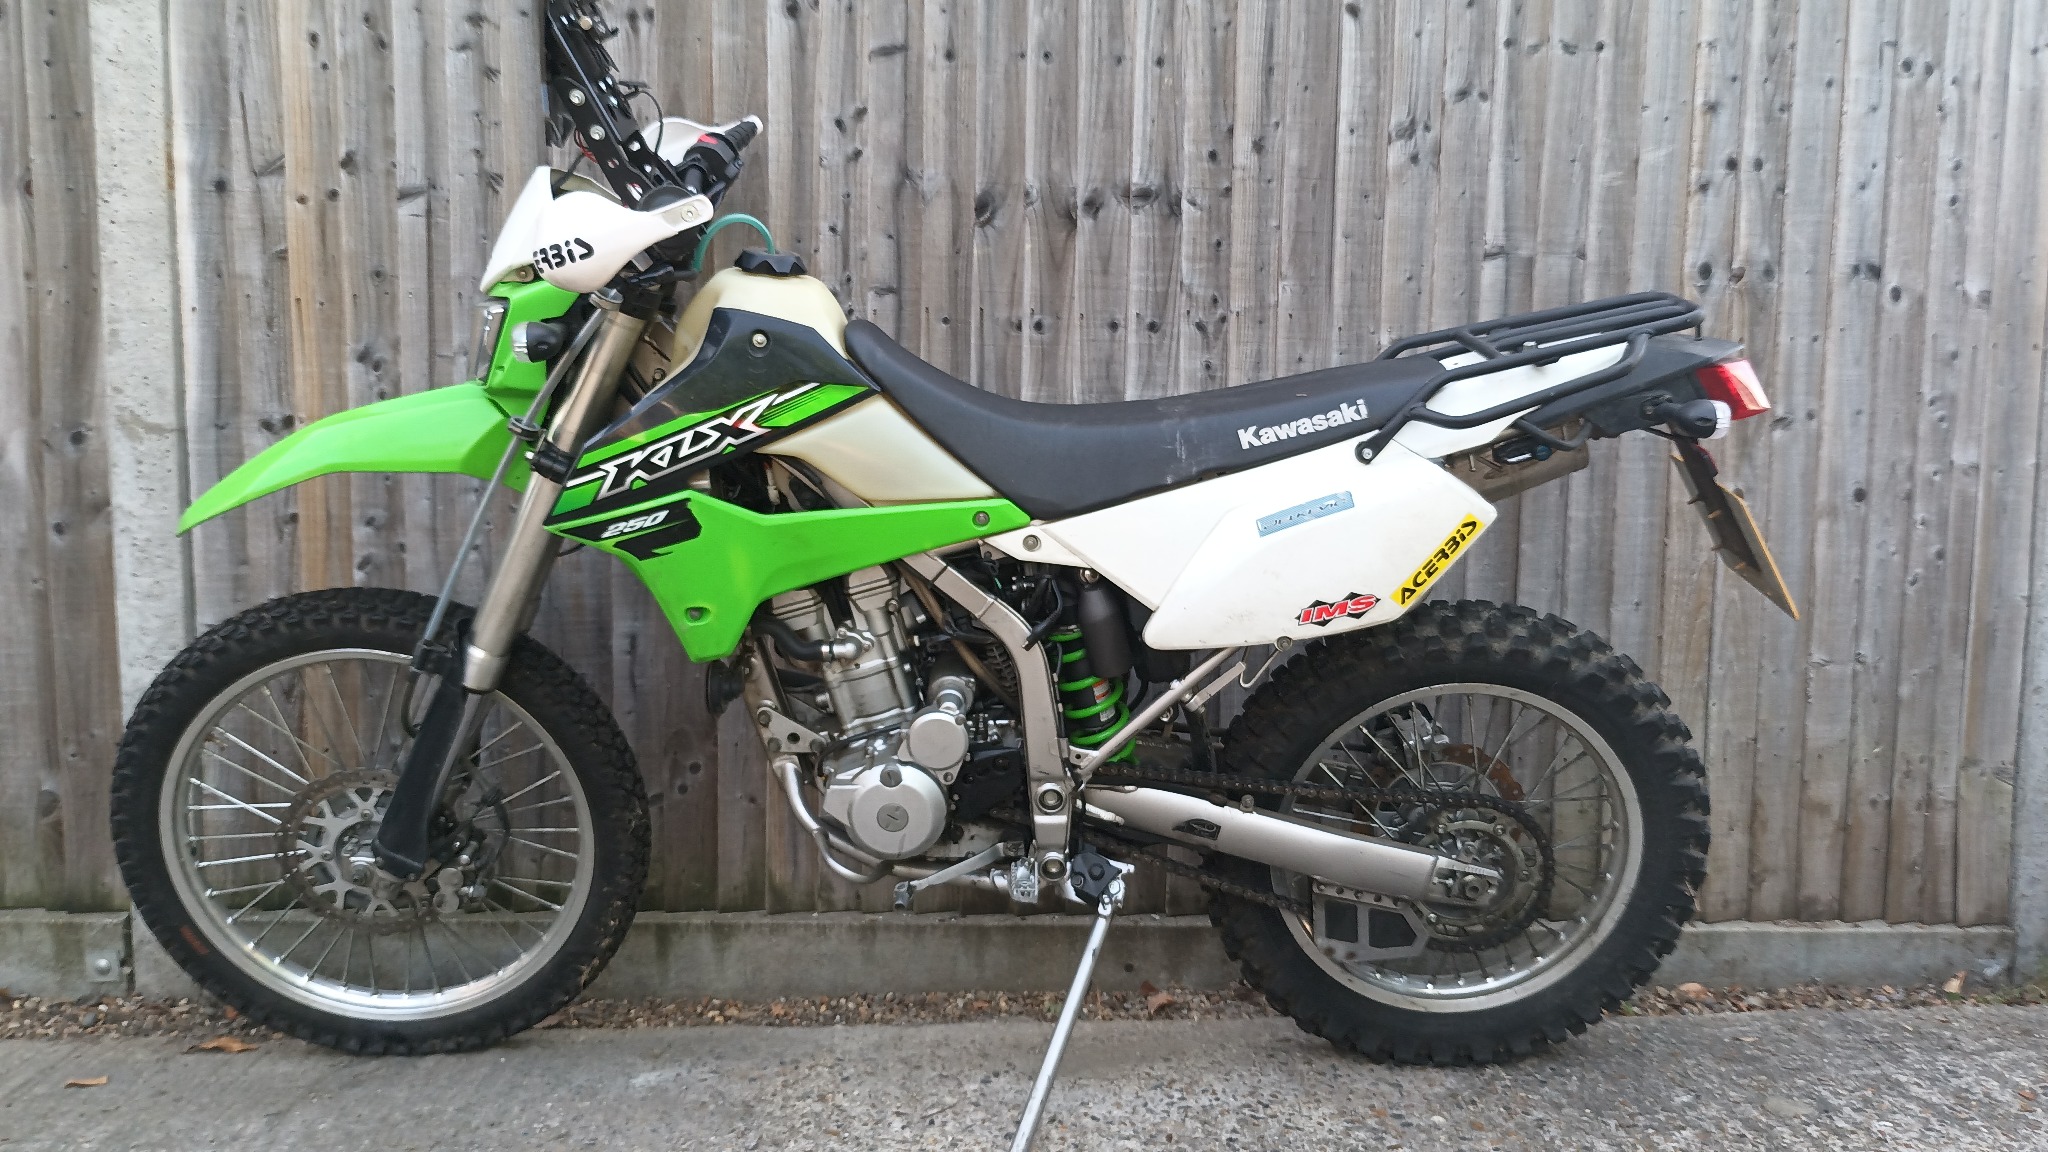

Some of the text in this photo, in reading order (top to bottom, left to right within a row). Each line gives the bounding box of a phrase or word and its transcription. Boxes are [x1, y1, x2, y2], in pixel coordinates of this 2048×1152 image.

[1237, 398, 1370, 450] Kawasaki
[600, 509, 670, 539] 250
[1298, 593, 1378, 626] IMS
